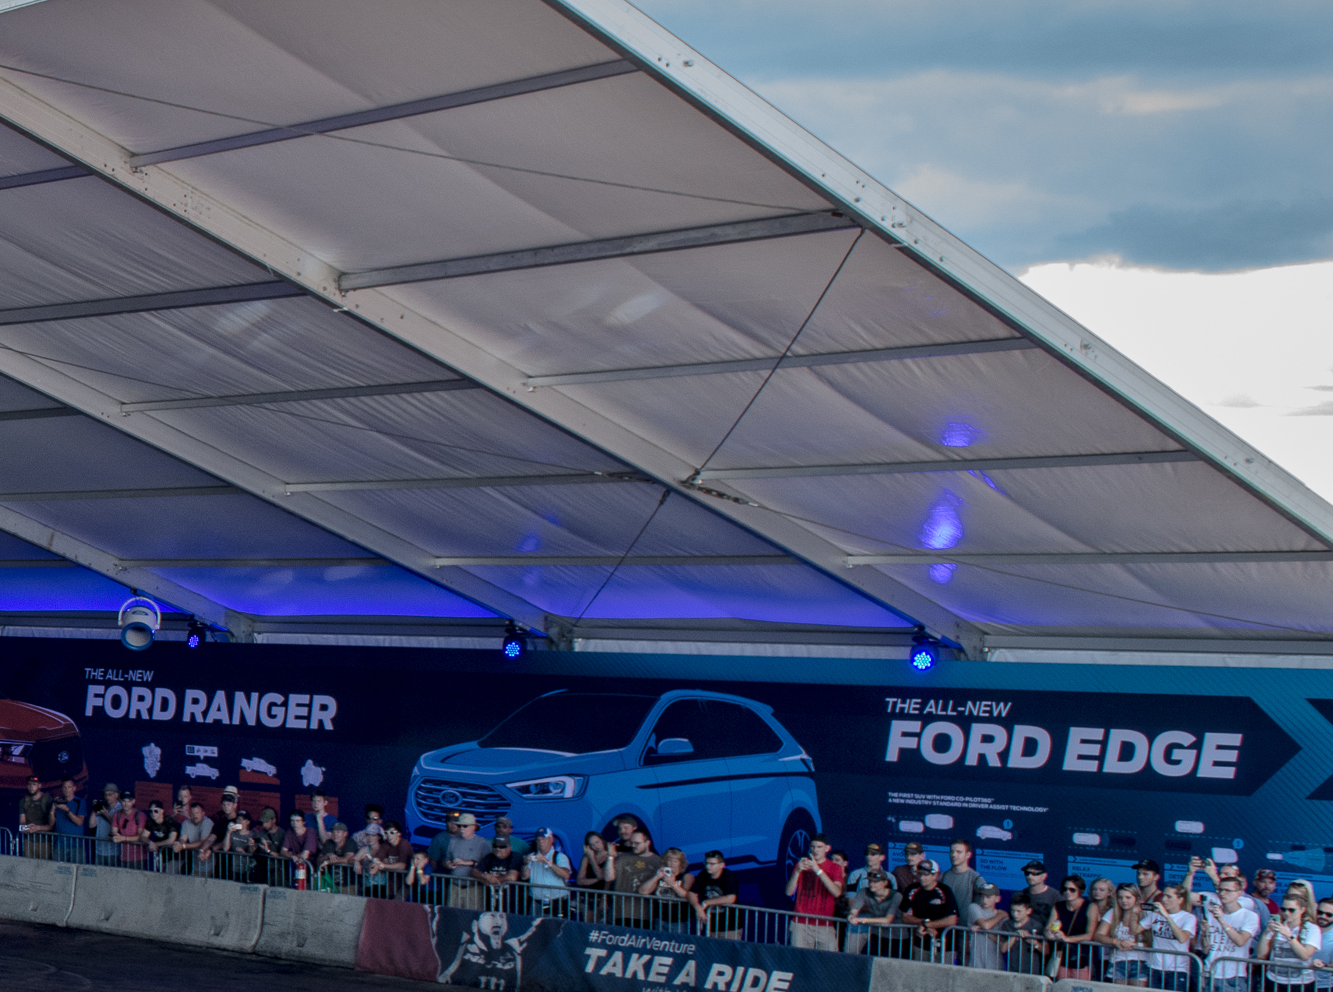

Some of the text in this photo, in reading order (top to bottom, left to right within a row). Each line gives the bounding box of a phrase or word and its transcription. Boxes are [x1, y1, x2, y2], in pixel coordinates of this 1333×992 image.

[84, 668, 154, 682] THE ALL-NEW
[85, 684, 337, 730] FORD RANGER
[885, 698, 1011, 717] THE ALL-NEW
[885, 720, 1243, 779] FORD EDGE
[589, 930, 696, 955] #FordAirVenture
[584, 947, 673, 983] TAKE
[673, 960, 696, 987] A
